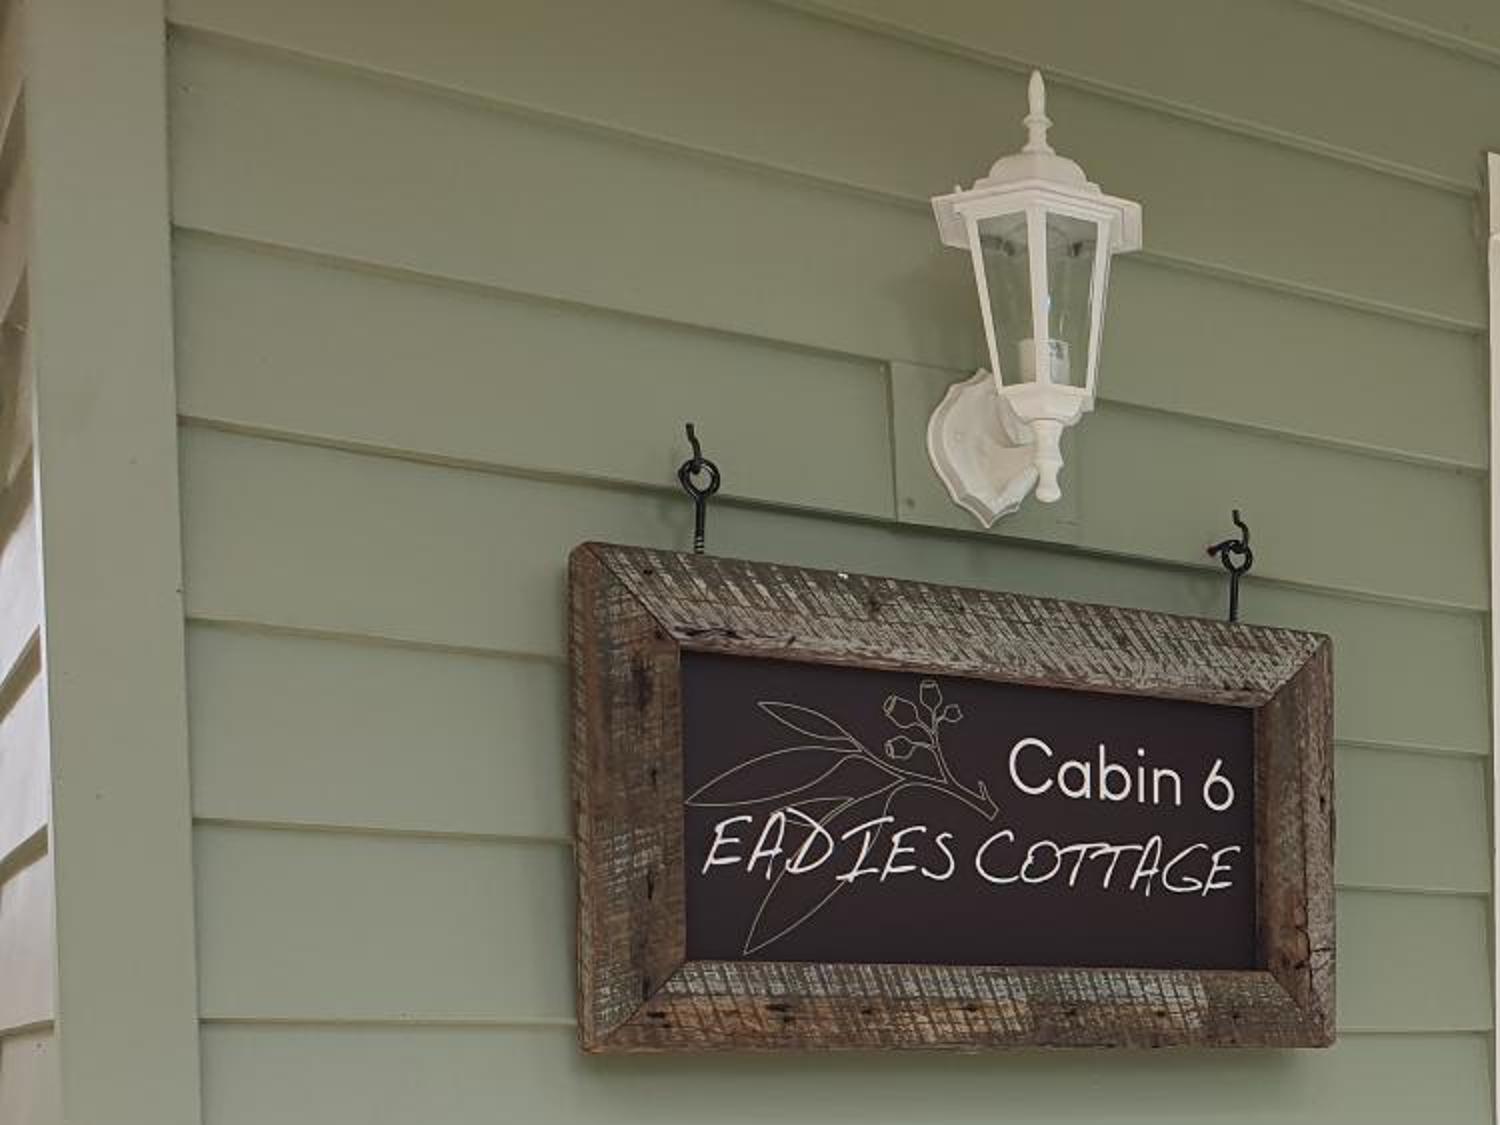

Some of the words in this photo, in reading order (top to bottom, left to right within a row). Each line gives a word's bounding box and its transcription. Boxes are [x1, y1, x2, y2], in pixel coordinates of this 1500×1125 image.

[1009, 737, 1182, 805] Cabin
[1203, 759, 1235, 811] 6
[702, 807, 955, 882] EADIES
[975, 829, 1241, 897] COTTAGE
